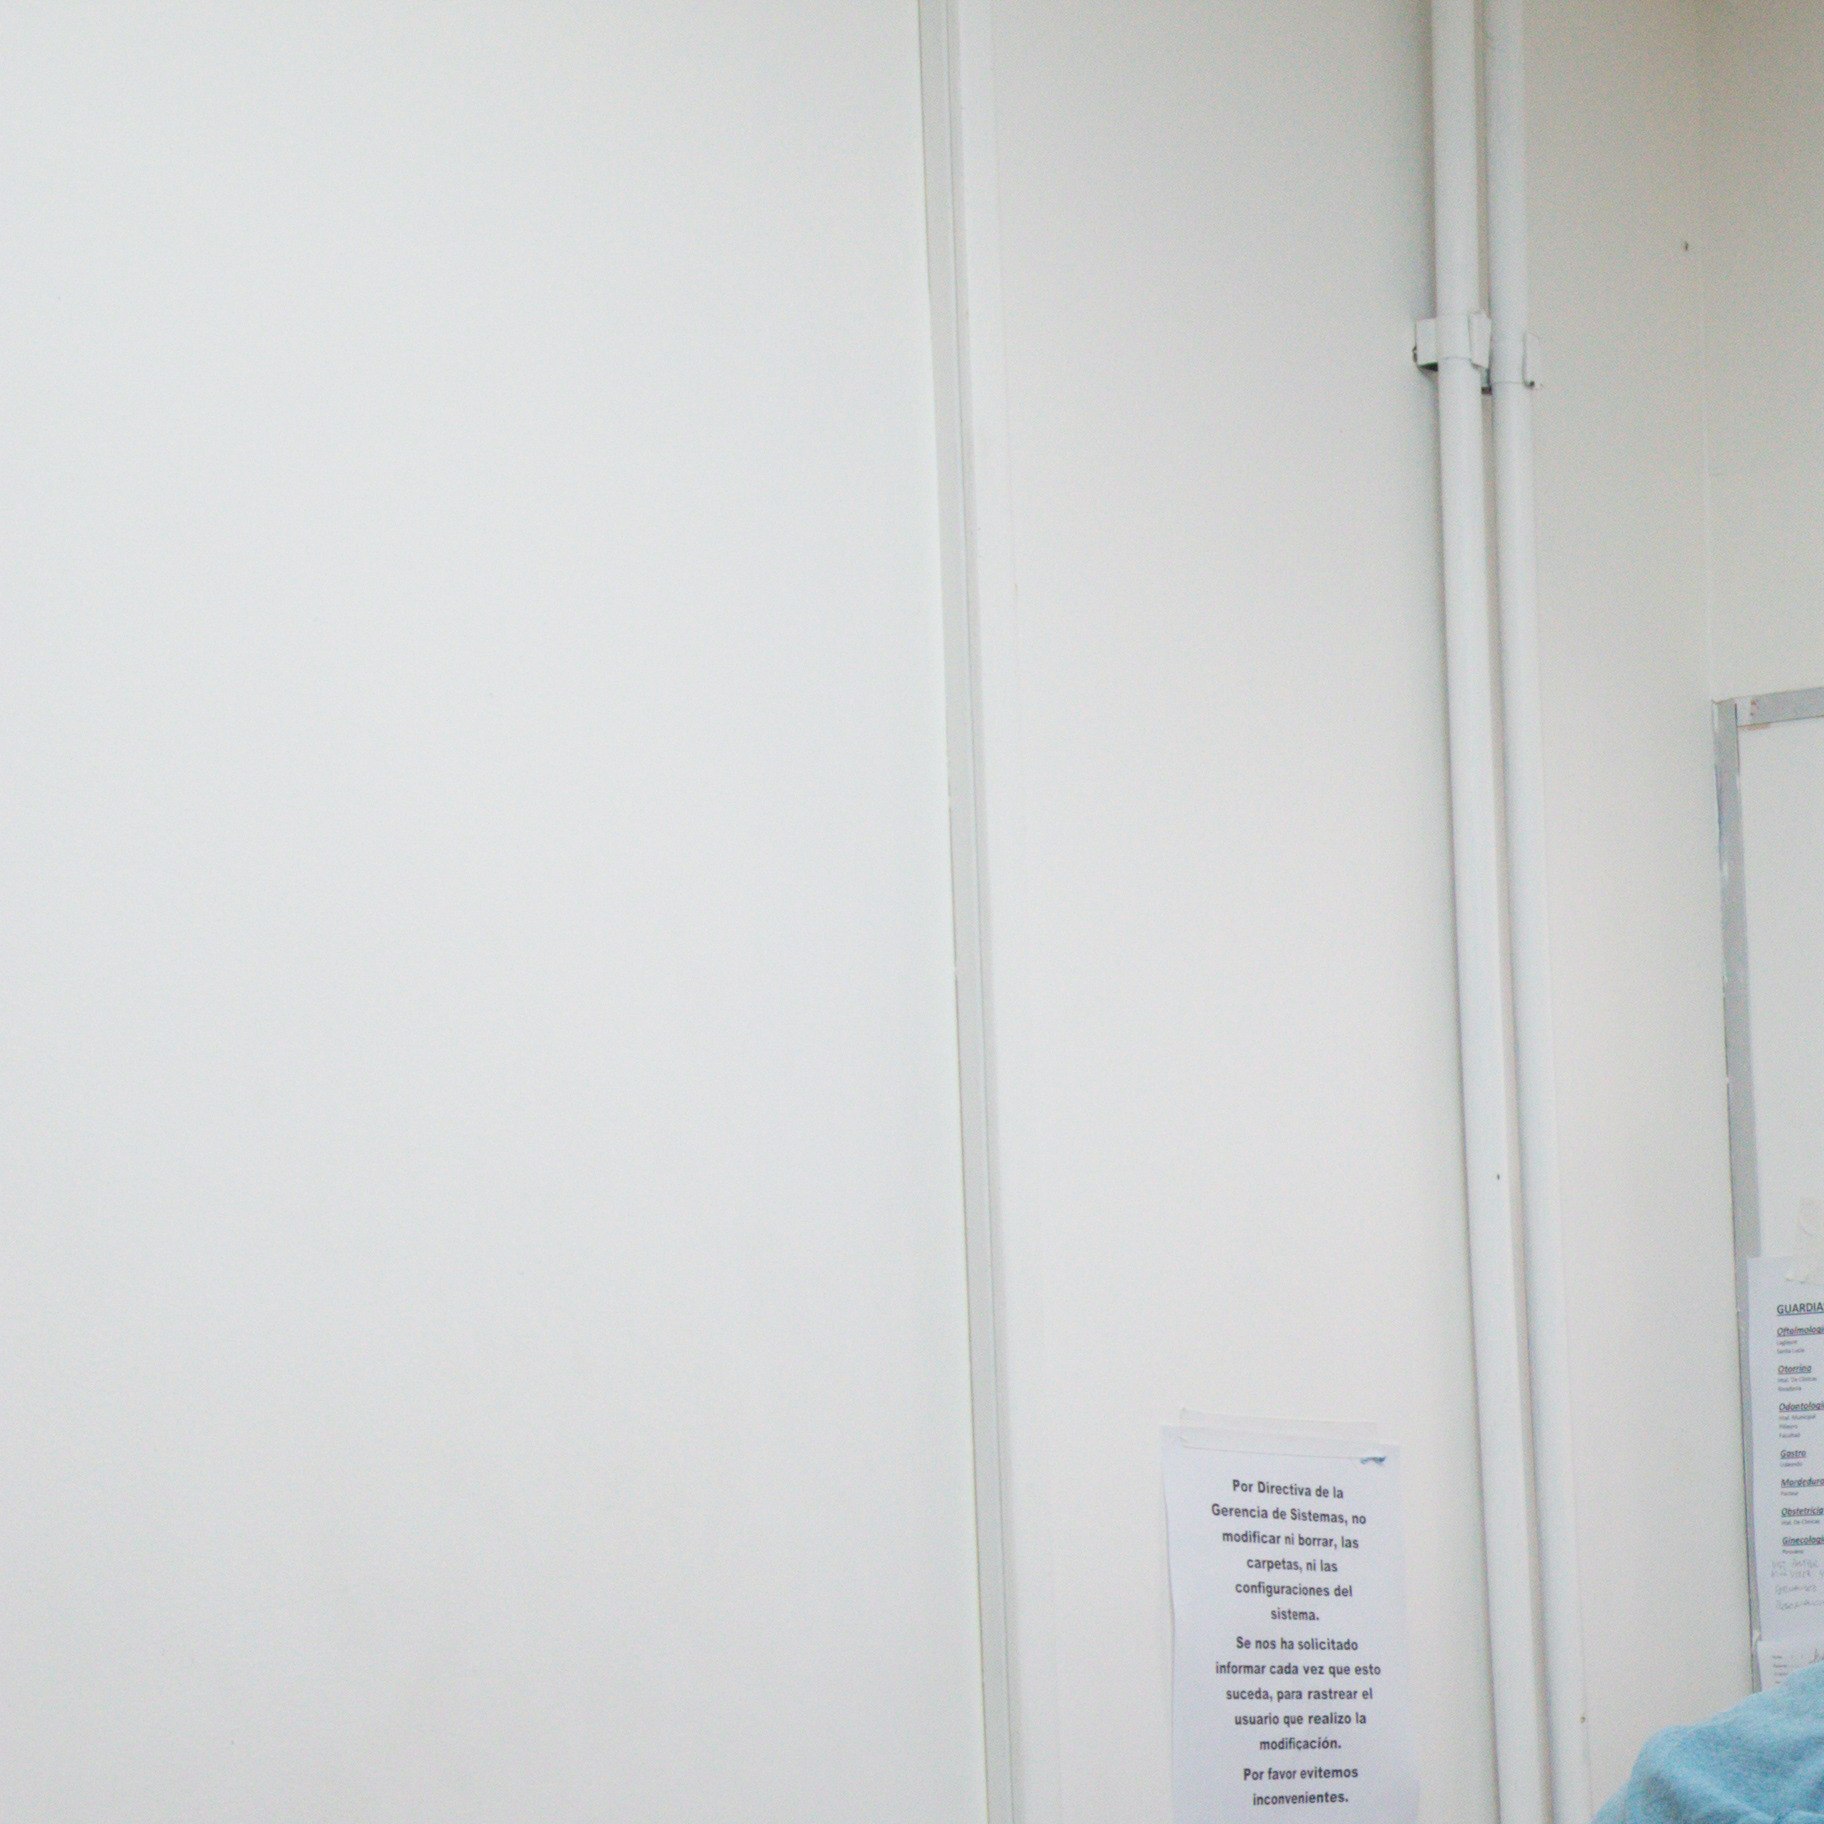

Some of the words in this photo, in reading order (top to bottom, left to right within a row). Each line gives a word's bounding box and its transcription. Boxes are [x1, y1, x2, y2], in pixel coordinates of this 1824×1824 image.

[1780, 1449, 1806, 1458] Gastro
[1232, 1479, 1253, 1495] Por
[1257, 1480, 1312, 1499] Directiva
[1315, 1484, 1329, 1498] de
[1333, 1486, 1344, 1499] la
[1211, 1503, 1268, 1520] Gerencia
[1272, 1506, 1287, 1521] de
[1290, 1508, 1349, 1526] Sistemas,
[1351, 1513, 1366, 1525] no
[1222, 1529, 1281, 1546] modificar
[1284, 1532, 1295, 1546] ni
[1298, 1533, 1337, 1549] borrar,
[1341, 1535, 1359, 1549] las
[1247, 1557, 1303, 1574] carpetas,
[1306, 1558, 1317, 1572] ni
[1320, 1559, 1338, 1573] las
[1235, 1581, 1330, 1600] configuraciones
[1333, 1583, 1352, 1597] del
[1271, 1607, 1320, 1621] sistema.
[1236, 1636, 1251, 1651] Se
[1255, 1638, 1276, 1652] nos
[1280, 1637, 1294, 1651] ha
[1297, 1637, 1358, 1652] solicitado
[1215, 1661, 1266, 1676] informar
[1269, 1662, 1299, 1676] cada
[1303, 1664, 1325, 1676] vez
[1329, 1663, 1351, 1679] que
[1354, 1662, 1381, 1676] esto
[1226, 1687, 1273, 1704] suceda,
[1276, 1688, 1303, 1705] para
[1307, 1687, 1359, 1701] rastrear
[1362, 1686, 1373, 1700] el
[1234, 1711, 1280, 1727] usuario
[1283, 1712, 1304, 1730] que
[1308, 1711, 1352, 1726] realizo
[1355, 1710, 1366, 1724] la
[1259, 1735, 1342, 1752] modificación.
[1244, 1767, 1264, 1782] Por
[1267, 1765, 1297, 1781] favor
[1300, 1765, 1358, 1780] evitemos
[1252, 1791, 1349, 1806] inconvenientes.
